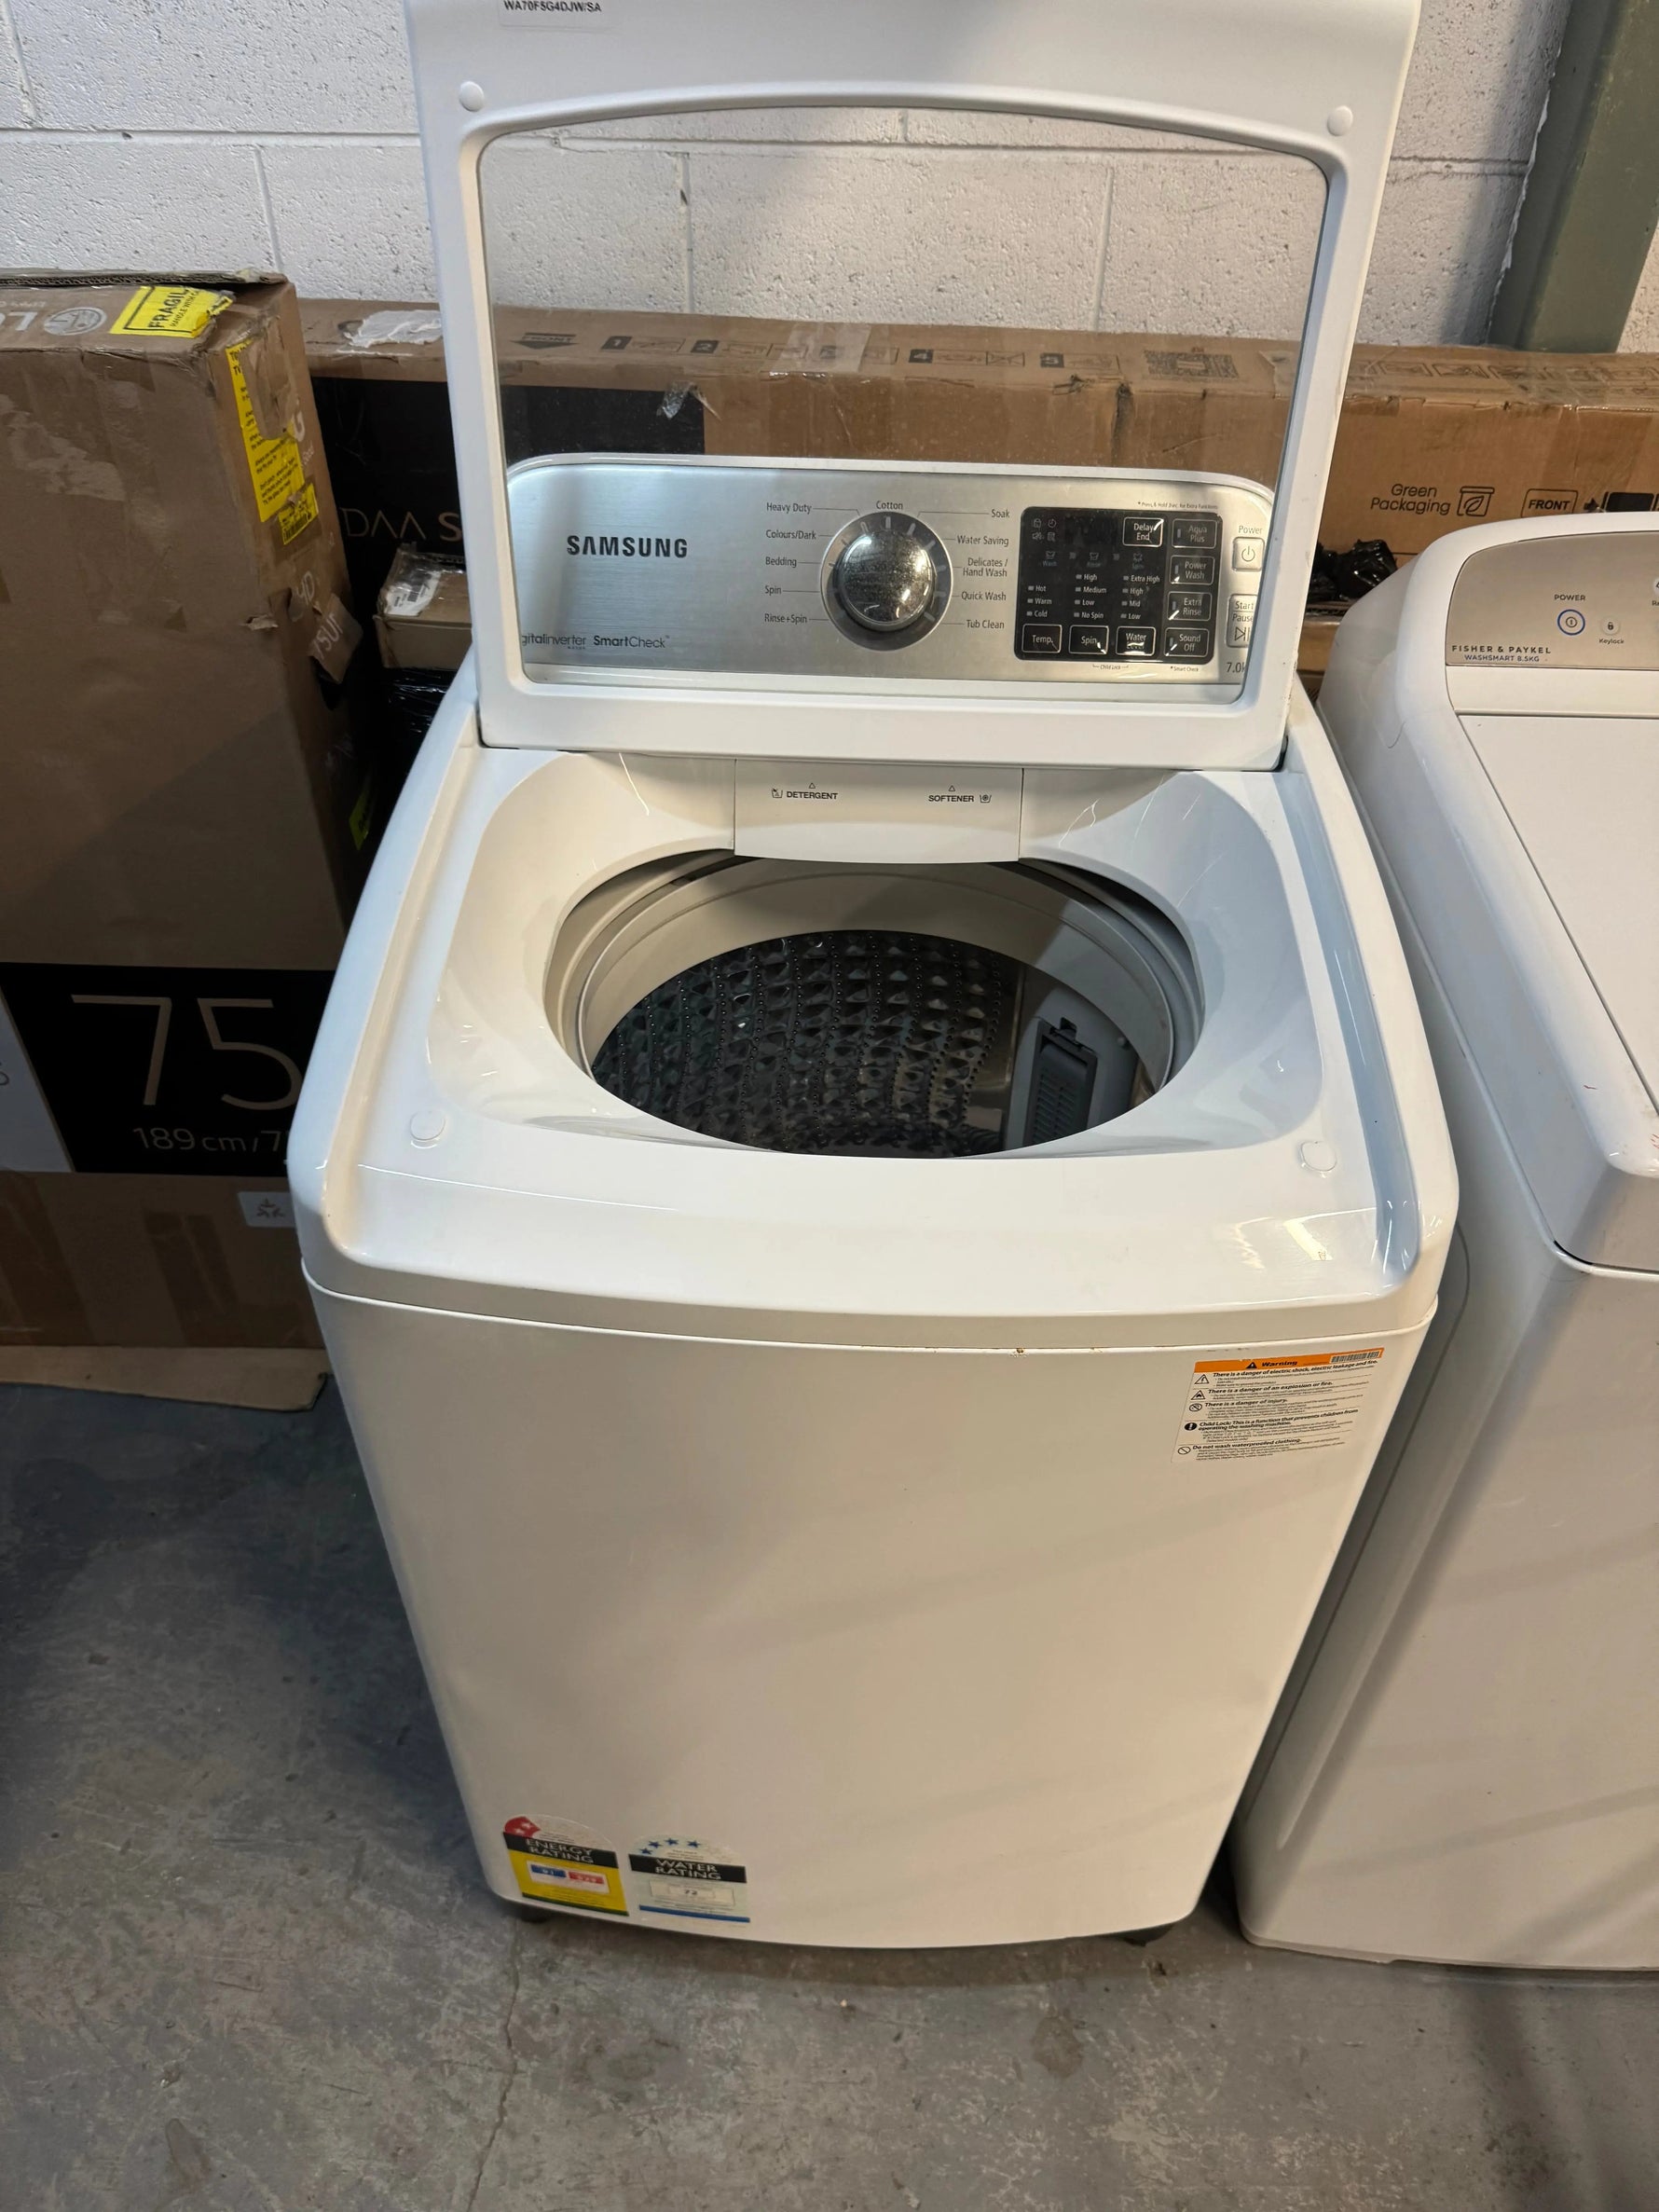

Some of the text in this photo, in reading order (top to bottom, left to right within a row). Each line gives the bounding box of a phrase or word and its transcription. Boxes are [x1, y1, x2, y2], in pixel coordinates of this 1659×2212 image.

[0, 311, 38, 331] L
[1391, 483, 1437, 498] Green
[766, 501, 812, 515] Heavy Duty
[876, 501, 903, 510] Cotton
[1370, 497, 1451, 515] Packaging
[1528, 499, 1570, 511] FRONT
[991, 508, 1009, 518] Soak
[1133, 522, 1154, 531] Delay
[1188, 525, 1207, 534] Aqua
[1238, 525, 1263, 535] Power
[765, 529, 816, 540] Colours/Dark
[1136, 532, 1150, 541] End
[1190, 534, 1205, 543] Plus
[956, 535, 1009, 547] Water Saving
[567, 535, 688, 558] SAMSUNG
[765, 556, 797, 569] Bedding
[967, 557, 1003, 567] Delicates
[1185, 561, 1206, 570] Power
[963, 568, 1008, 578] Hand Wash
[1083, 573, 1097, 583] High
[1185, 570, 1205, 579] Wash
[1131, 574, 1160, 584] Extra High
[764, 585, 782, 596] Spin
[1130, 587, 1144, 596] High
[961, 591, 1007, 601] Quick Wash
[1184, 598, 1202, 606] Extra
[1235, 600, 1254, 610] Start
[1090, 611, 1104, 620] Spin
[1183, 607, 1201, 615] Rinse
[966, 619, 1005, 629] Tub Clean
[1081, 636, 1097, 645] Spin
[1125, 633, 1146, 641] Water
[1179, 633, 1200, 642] Sound
[1184, 643, 1195, 652] Off
[787, 790, 838, 800] DETERGENT
[928, 794, 974, 803] SOFTENER
[71, 994, 301, 1110] 75
[526, 1838, 593, 1855] ENERGY
[528, 1846, 594, 1863] RATING
[655, 1858, 718, 1873] WATER
[654, 1866, 722, 1880] RATING
